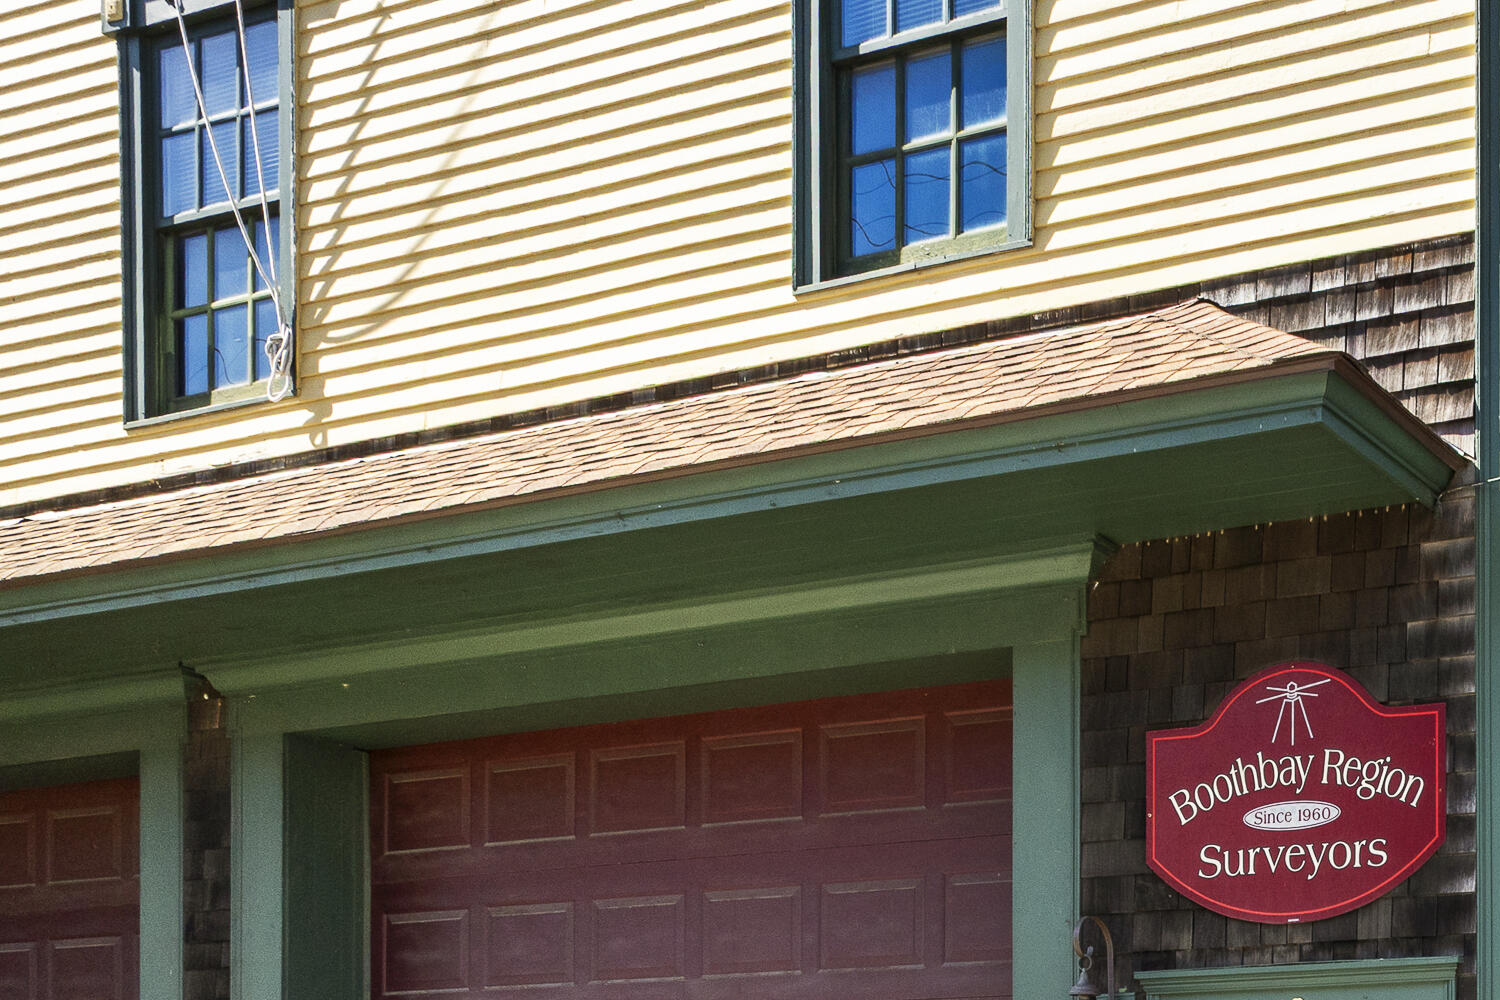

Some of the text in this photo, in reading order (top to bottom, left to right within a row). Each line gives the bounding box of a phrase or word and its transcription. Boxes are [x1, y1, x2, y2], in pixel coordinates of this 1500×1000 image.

[1168, 748, 1426, 826] Boothbay Region
[1253, 806, 1332, 825] Since 1960
[1197, 837, 1388, 881] Surveyors
